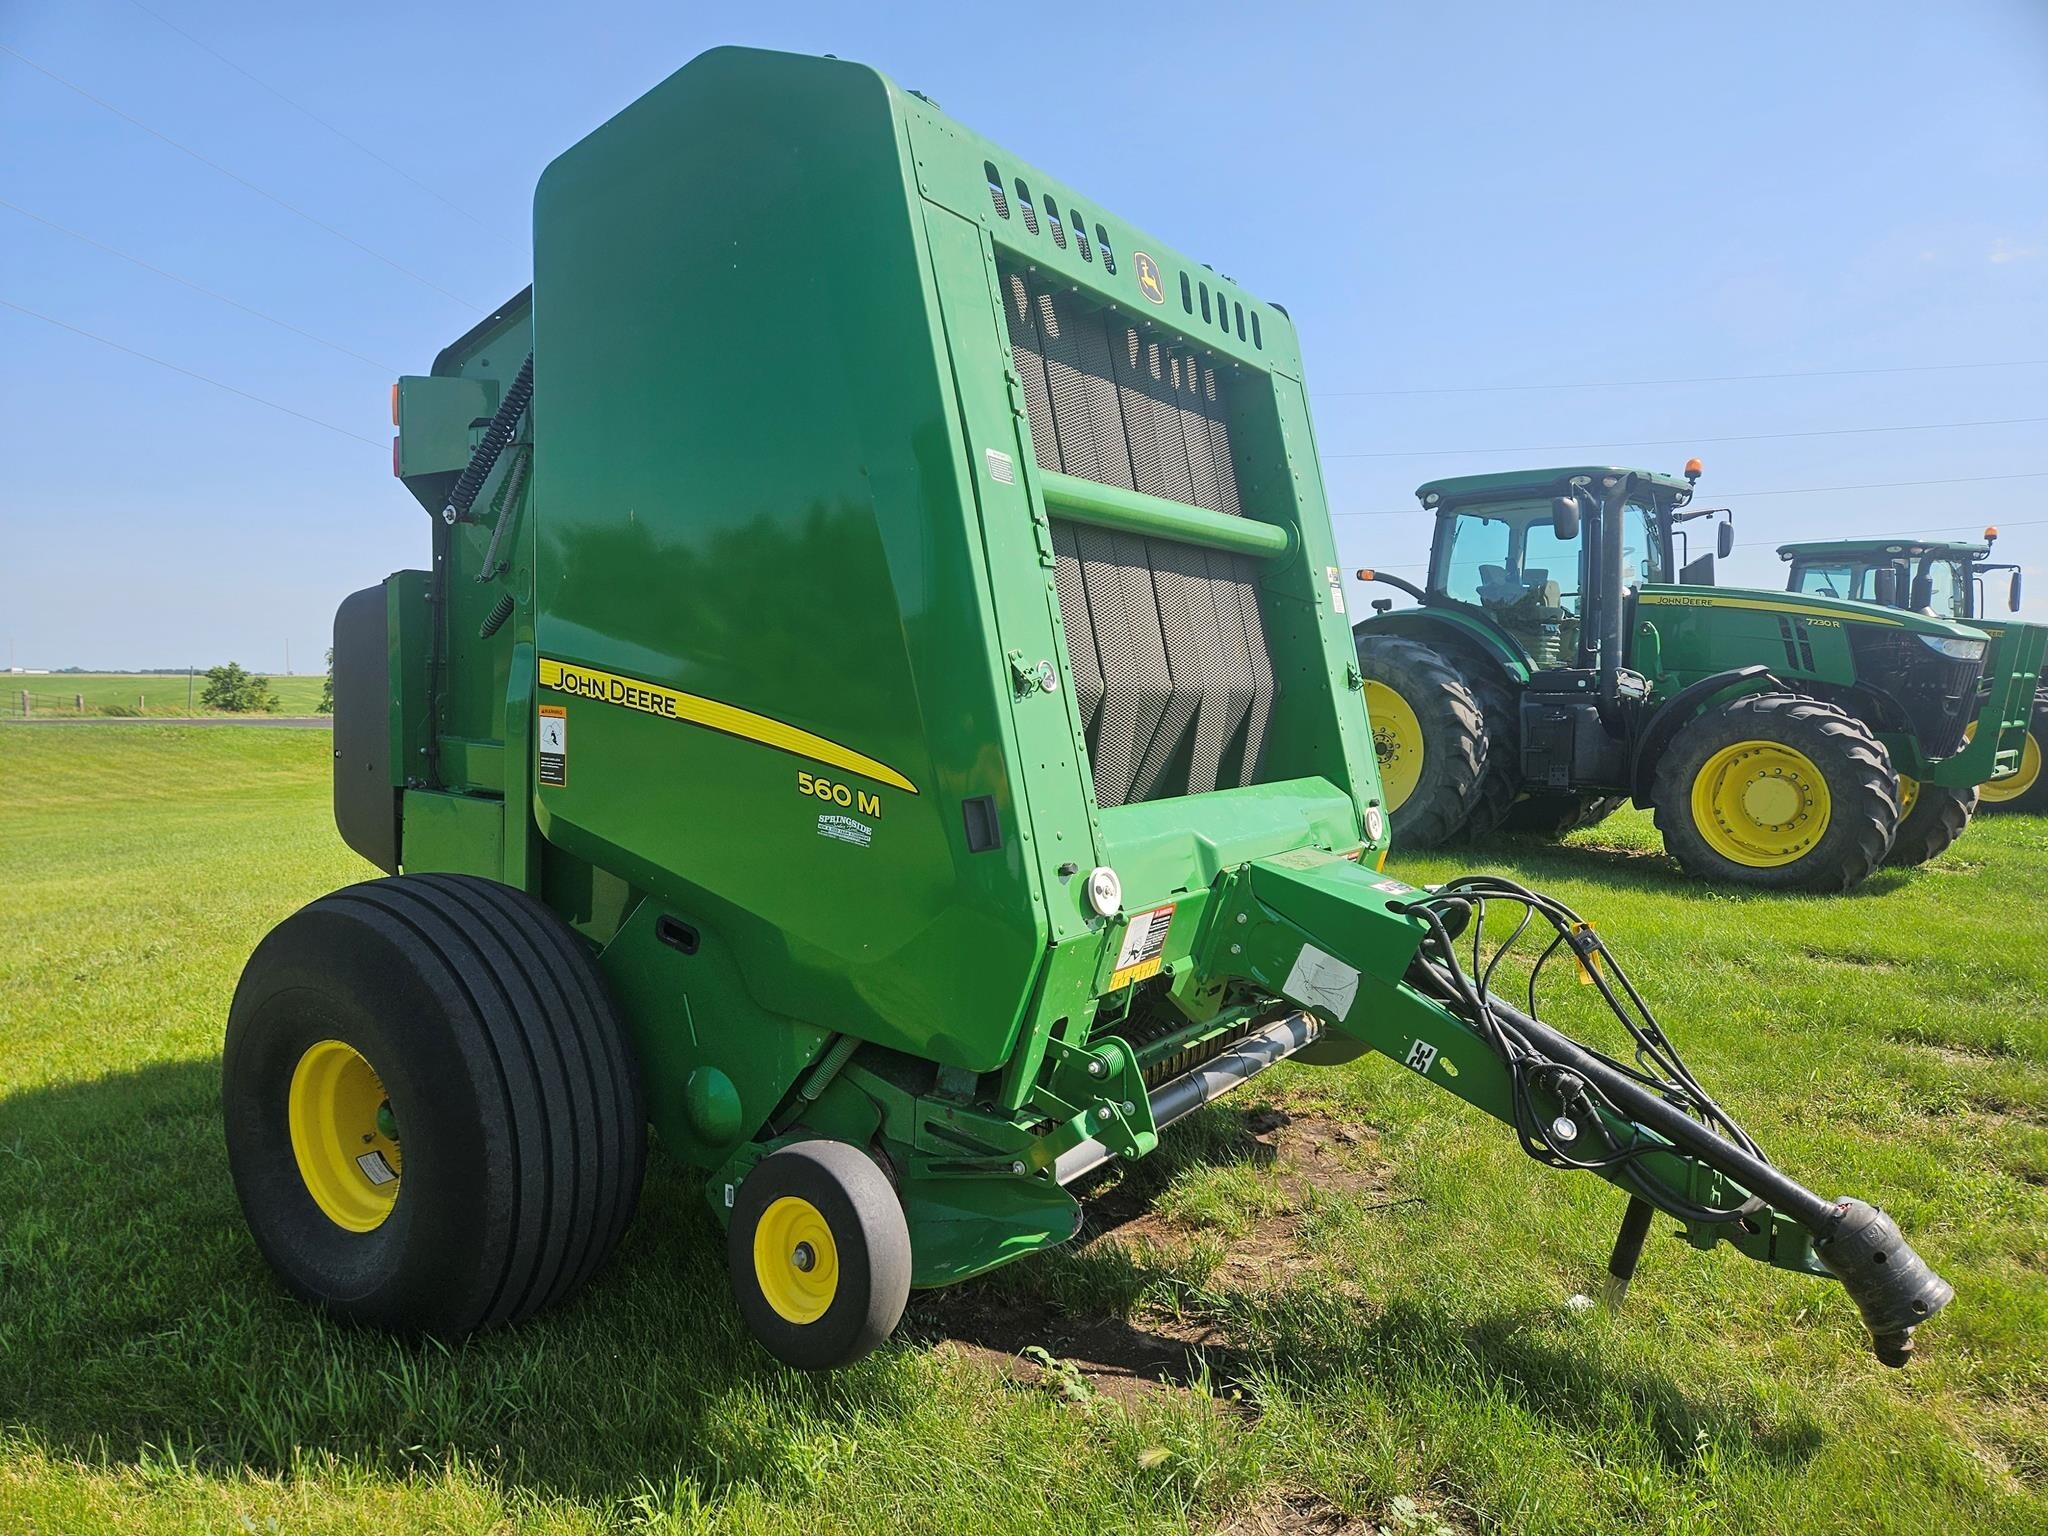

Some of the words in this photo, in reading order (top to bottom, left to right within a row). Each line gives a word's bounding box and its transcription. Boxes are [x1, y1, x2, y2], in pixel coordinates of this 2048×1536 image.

[1656, 596, 1681, 604] JOHN
[1682, 597, 1713, 606] DEERE
[1806, 618, 1832, 627] 7230
[1832, 620, 1840, 628] R
[553, 667, 606, 698] JOHN
[609, 678, 677, 716] DEERE
[798, 770, 853, 807] 560
[857, 789, 881, 819] M
[818, 814, 872, 836] SPRINGSIDE
